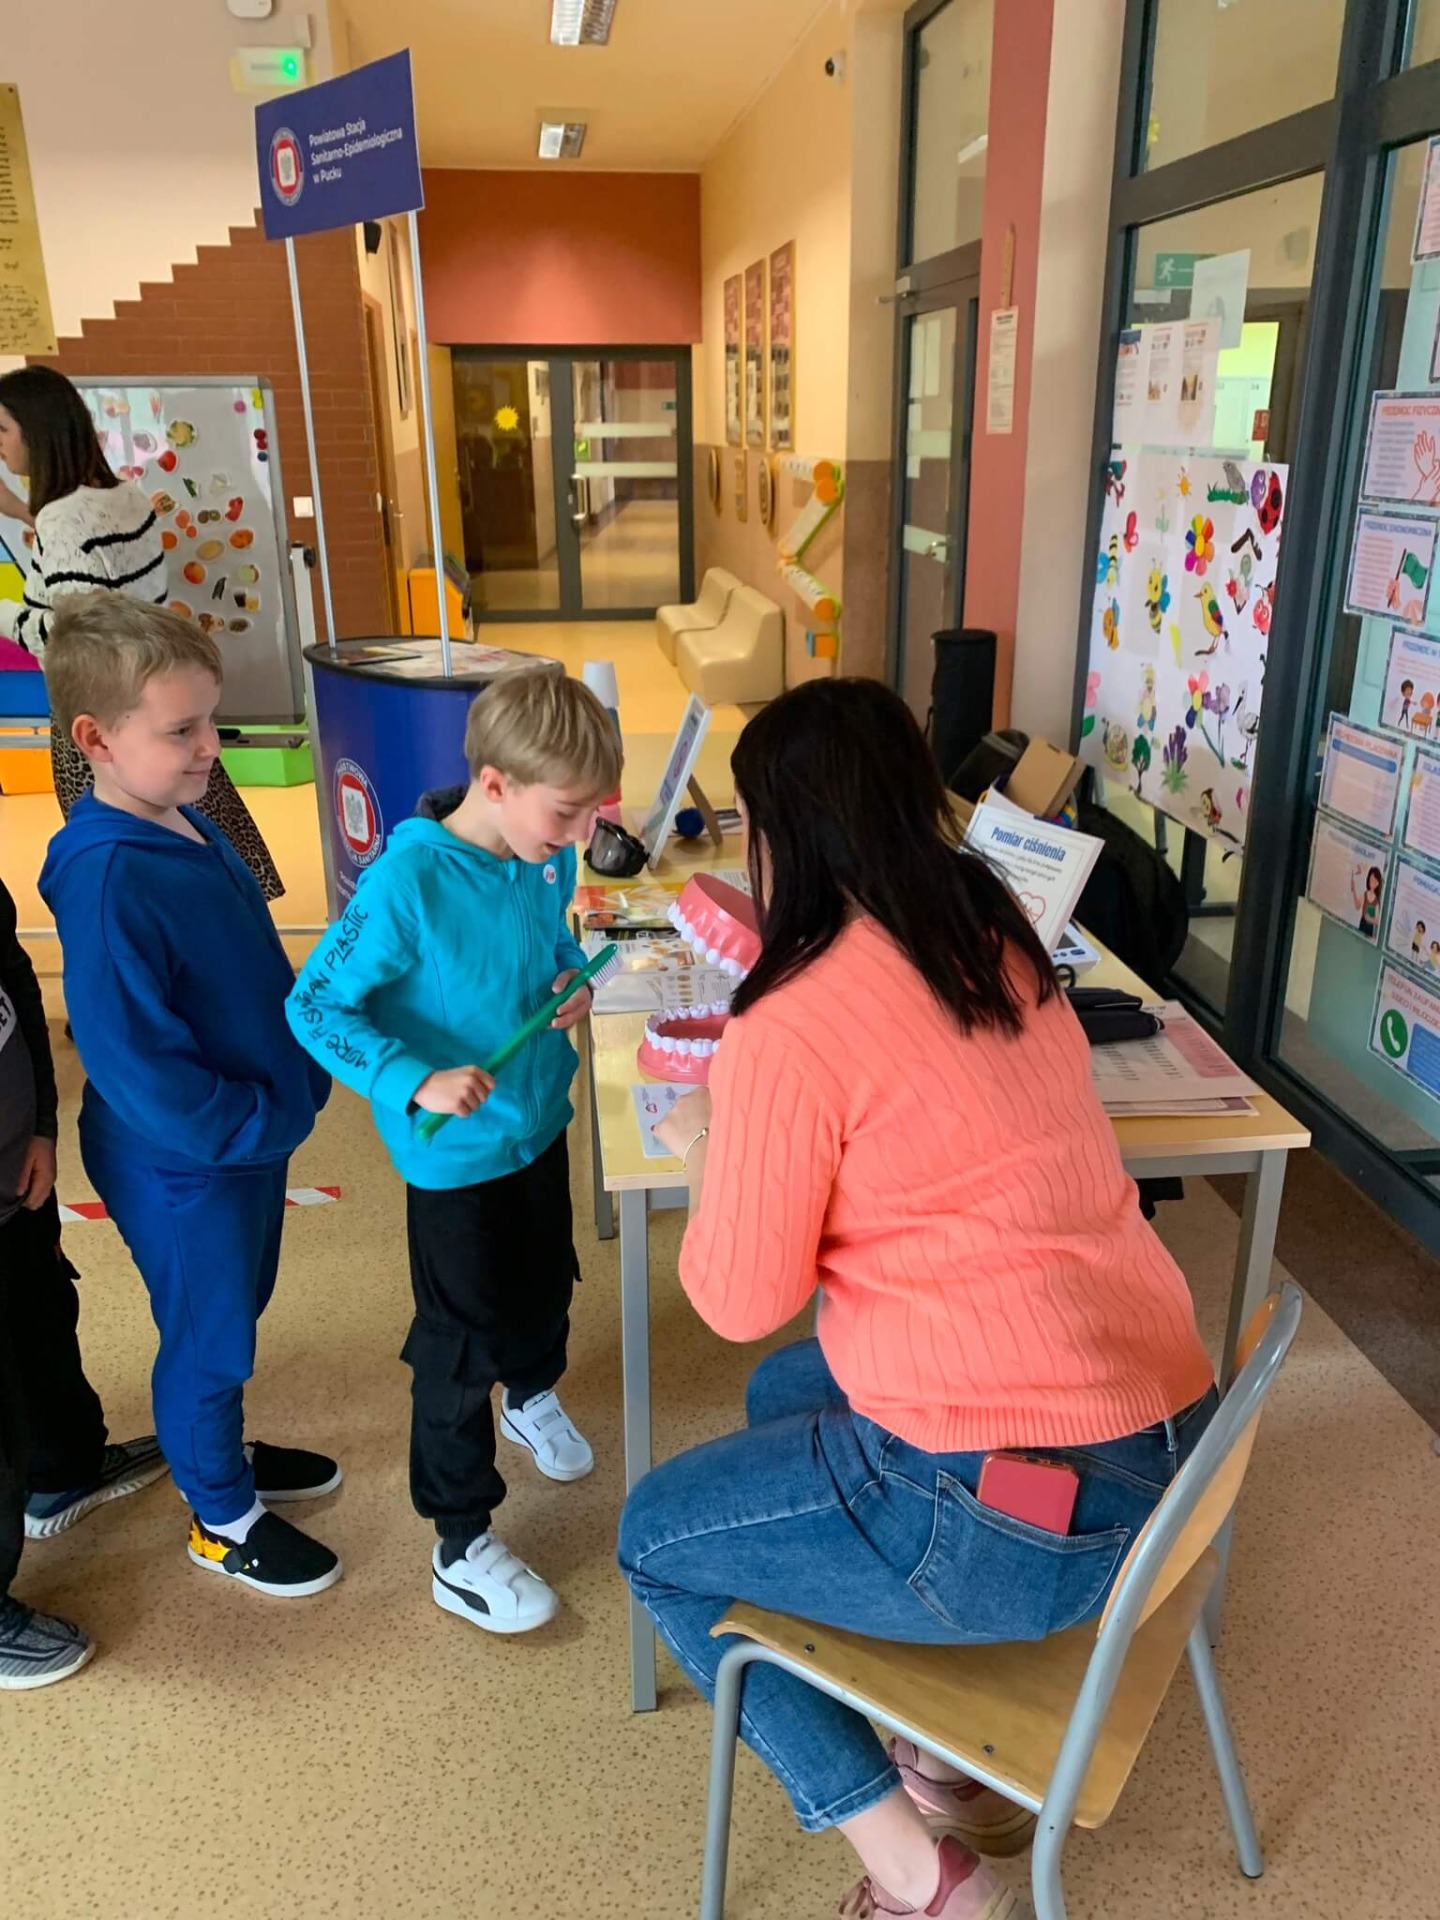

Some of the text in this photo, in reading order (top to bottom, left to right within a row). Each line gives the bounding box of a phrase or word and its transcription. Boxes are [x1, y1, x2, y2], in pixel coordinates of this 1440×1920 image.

[309, 127, 346, 149] Powiatowa
[346, 117, 367, 137] Stacja
[320, 167, 342, 182] Pucku
[991, 826, 1066, 862] Pomiar ciśnienia
[324, 903, 369, 972] PLASTIC
